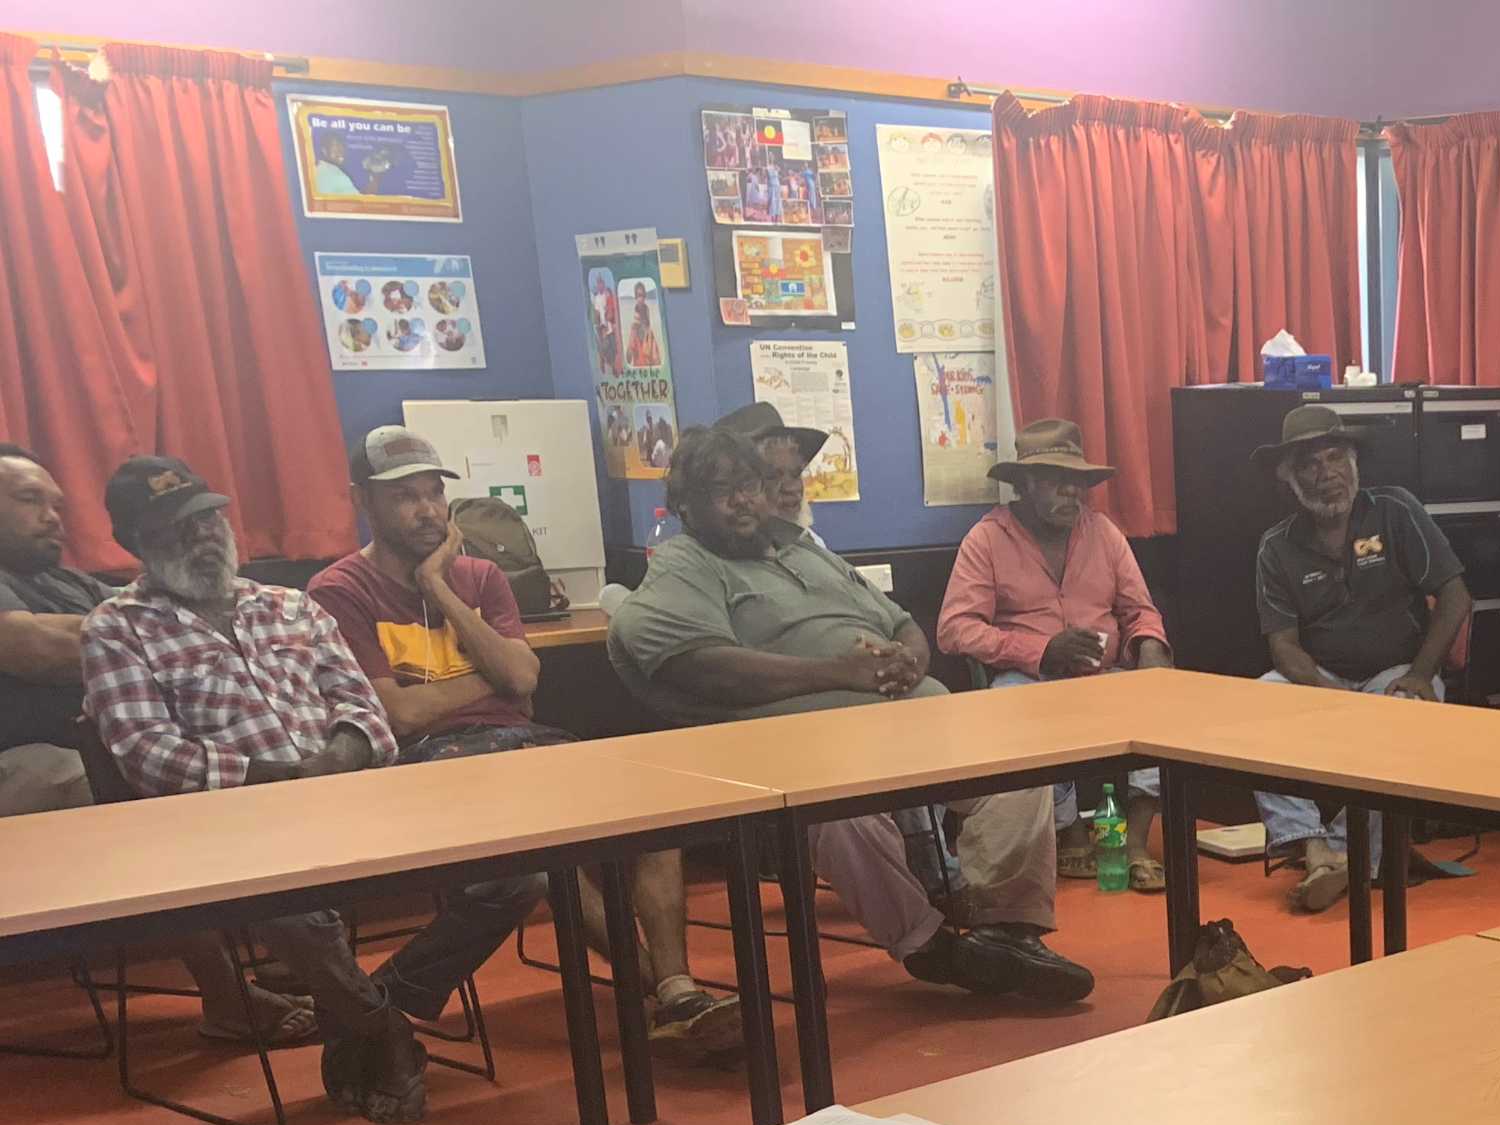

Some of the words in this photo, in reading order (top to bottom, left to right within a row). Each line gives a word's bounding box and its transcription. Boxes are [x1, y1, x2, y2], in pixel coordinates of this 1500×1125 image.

[311, 117, 327, 129] Be
[330, 119, 346, 130] all
[349, 121, 371, 133] you
[373, 123, 395, 133] can
[397, 124, 412, 134] be
[772, 352, 795, 360] Rights
[601, 379, 668, 401] TOGETHER
[532, 526, 549, 537] KIT
